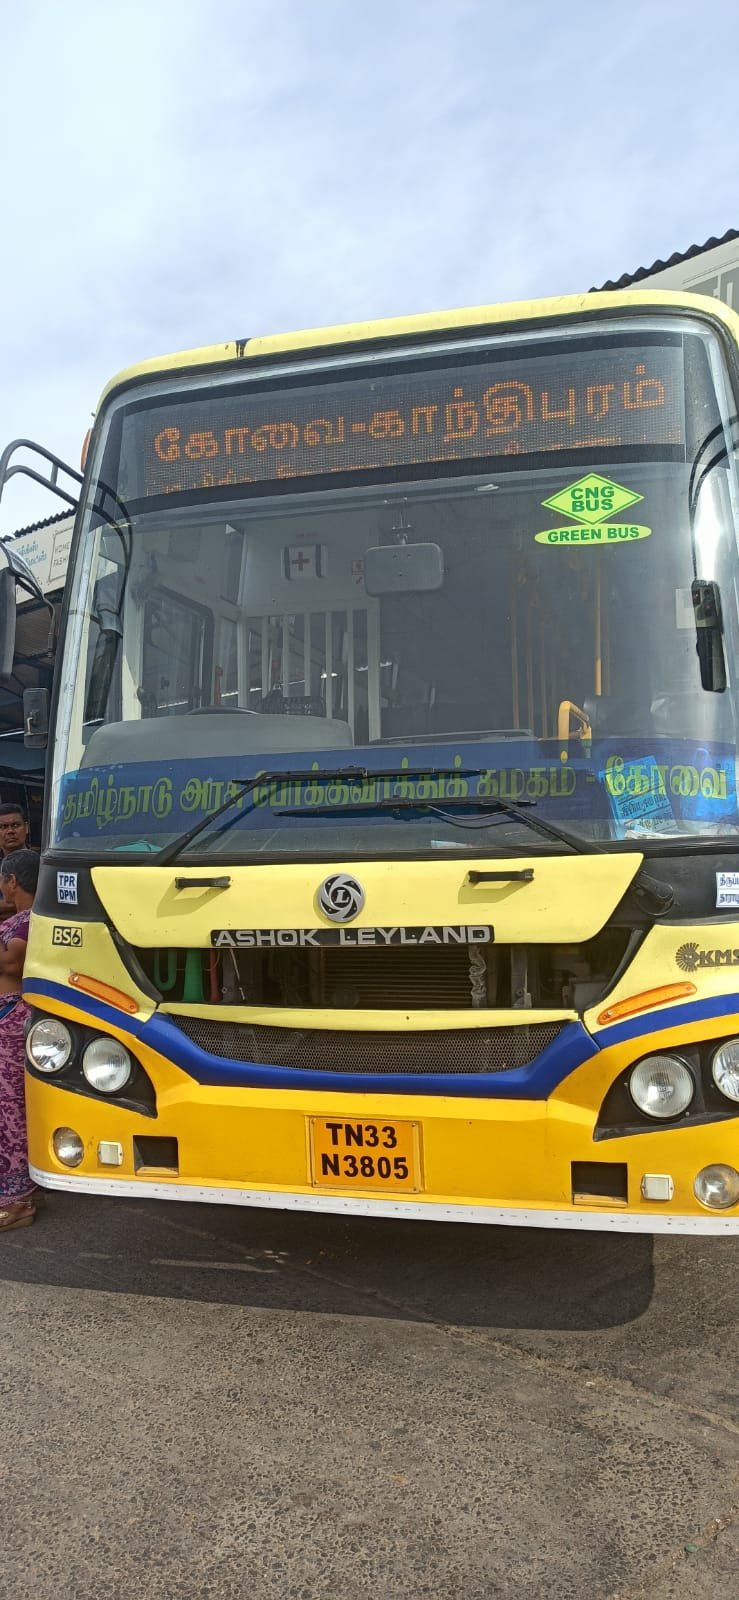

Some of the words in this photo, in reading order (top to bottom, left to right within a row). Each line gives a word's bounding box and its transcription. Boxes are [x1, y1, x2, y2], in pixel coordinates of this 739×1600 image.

[153, 363, 667, 463] கோவை-காந்திபுரம்
[570, 486, 615, 500] CNG
[571, 499, 613, 512] BUS
[547, 528, 601, 542] GREEN
[607, 527, 640, 538] BUS
[62, 774, 172, 827] தமிழ்நாடு
[605, 754, 727, 800] கோவை
[59, 875, 76, 887] TPR
[59, 889, 77, 902] DPM
[53, 927, 82, 947] BS6
[215, 929, 321, 947] ASHOK
[339, 926, 491, 946] LEYLAND
[325, 1122, 398, 1149] TN33
[321, 1153, 409, 1179] N3805
